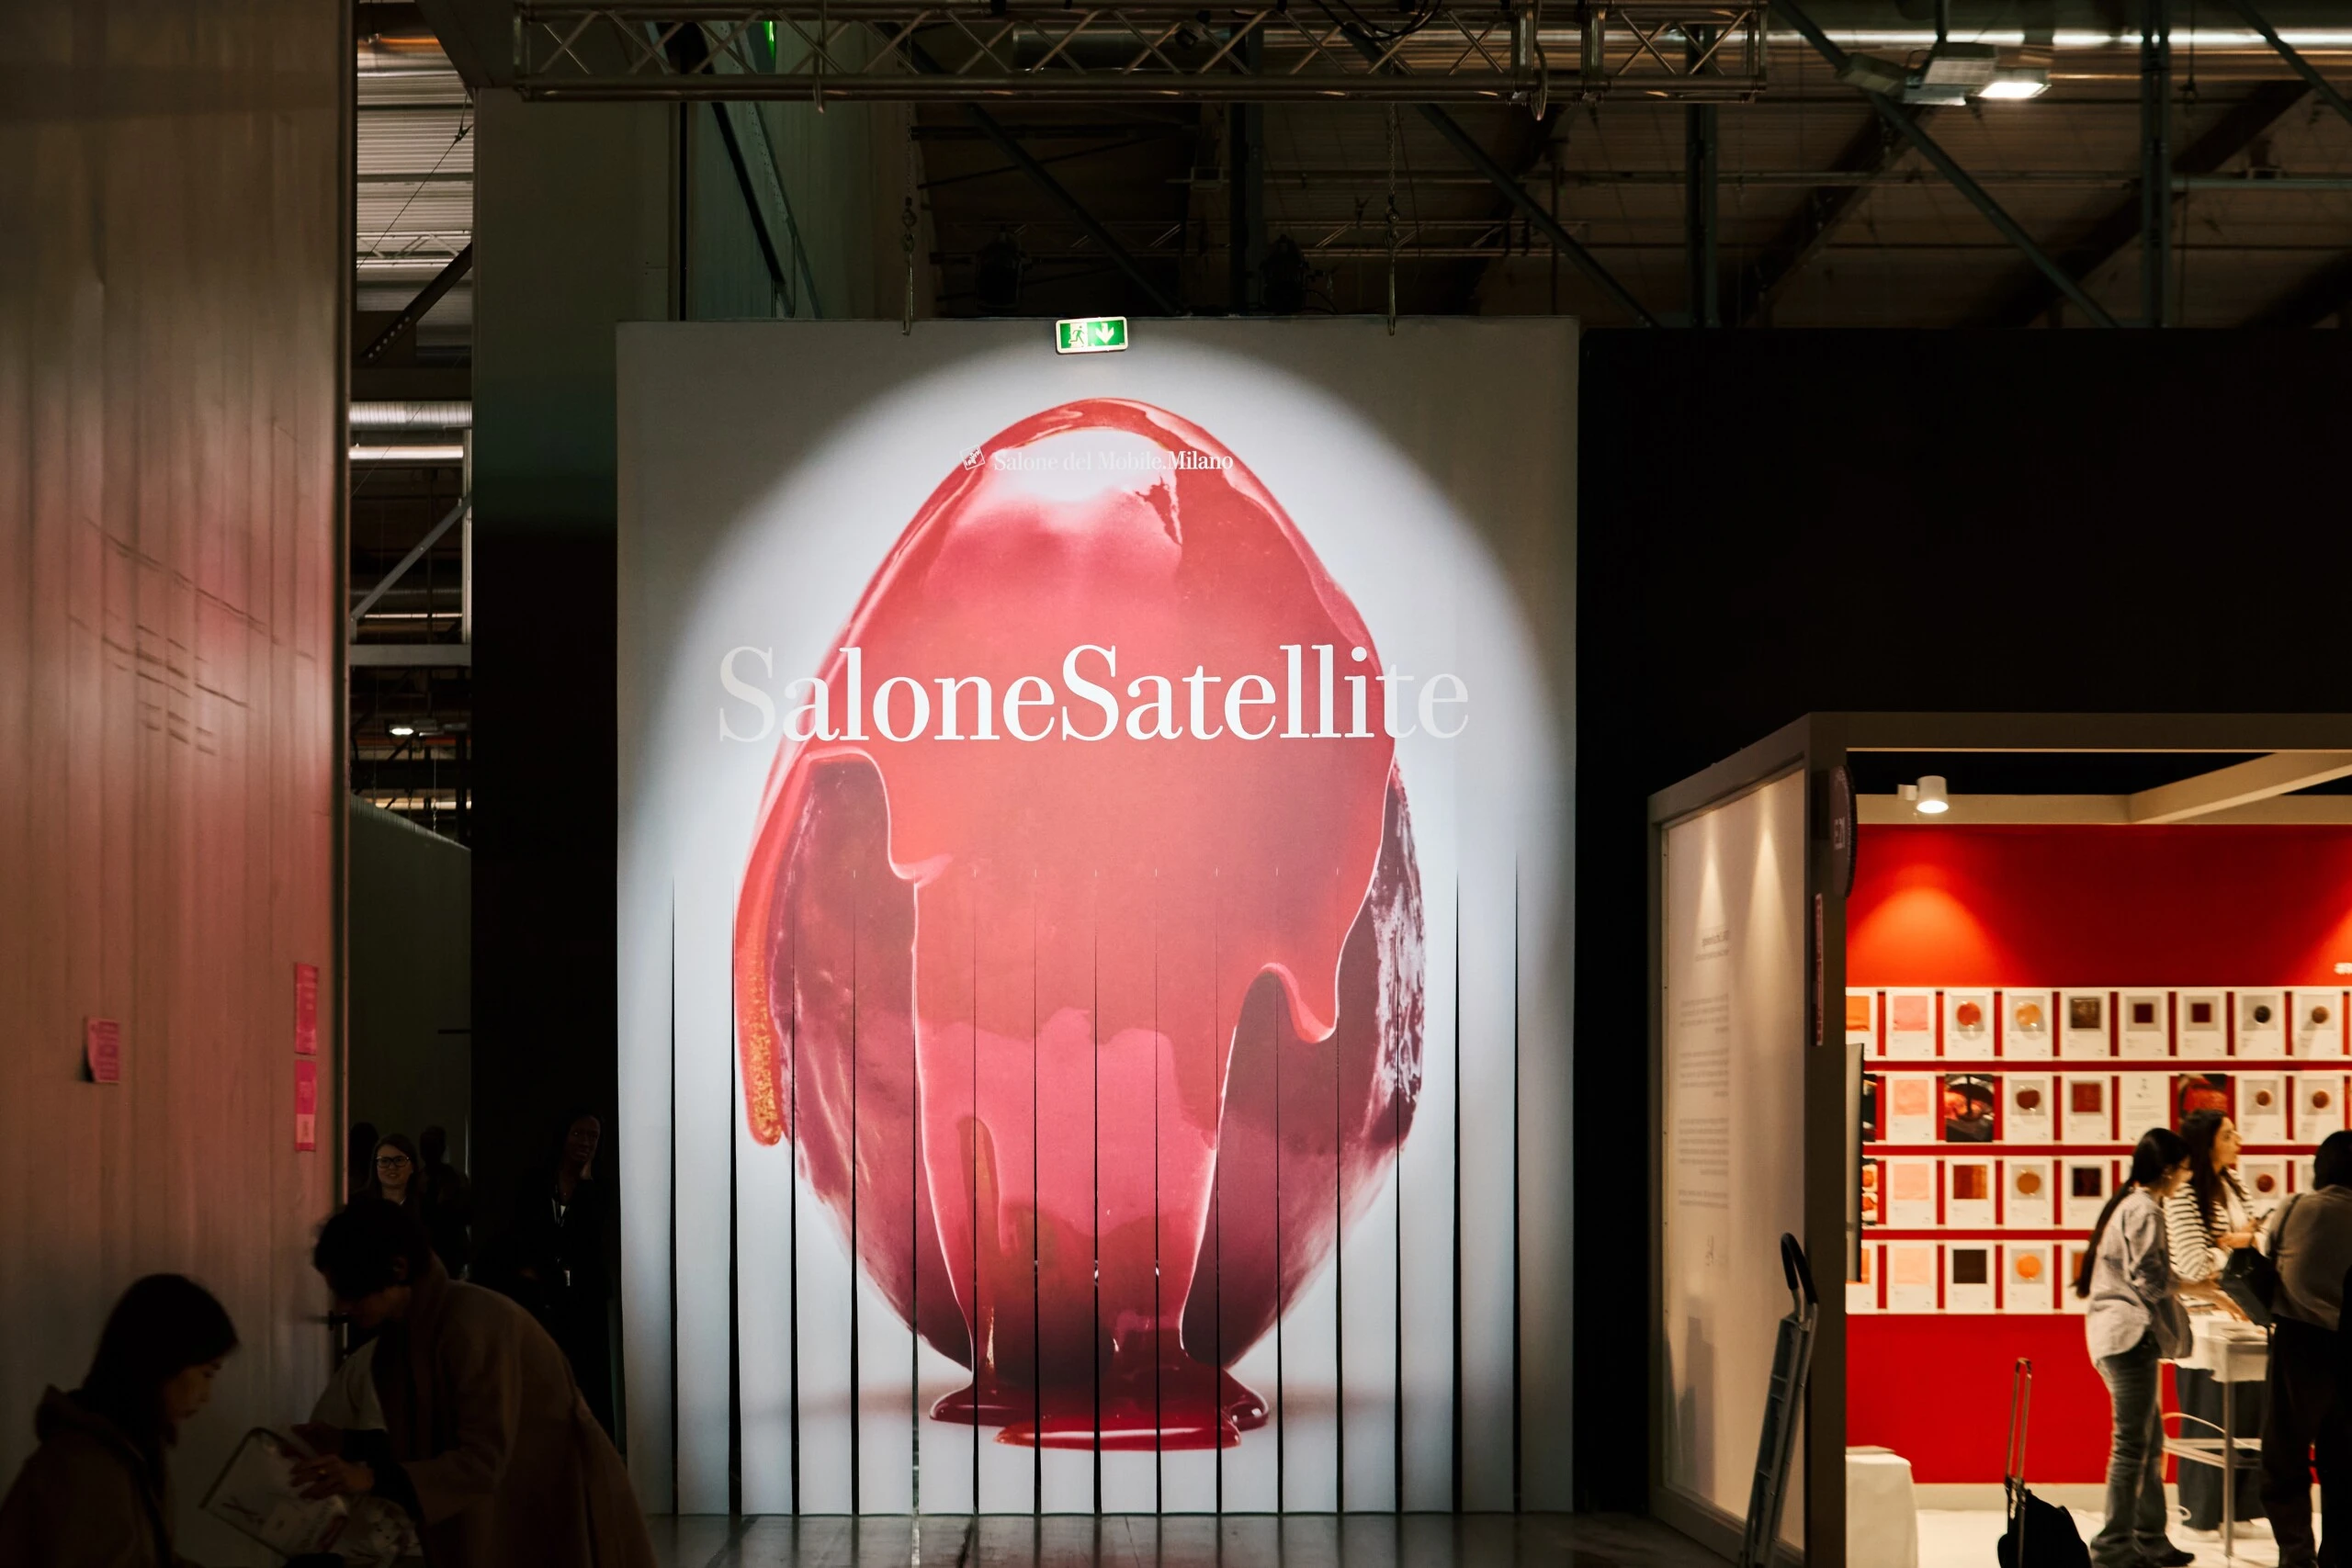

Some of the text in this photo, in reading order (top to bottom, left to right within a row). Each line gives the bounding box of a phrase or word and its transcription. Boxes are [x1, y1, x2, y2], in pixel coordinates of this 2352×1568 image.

[993, 451, 1059, 471] Salone
[1063, 450, 1091, 471] del
[718, 644, 1470, 741] SaloneSatellite
